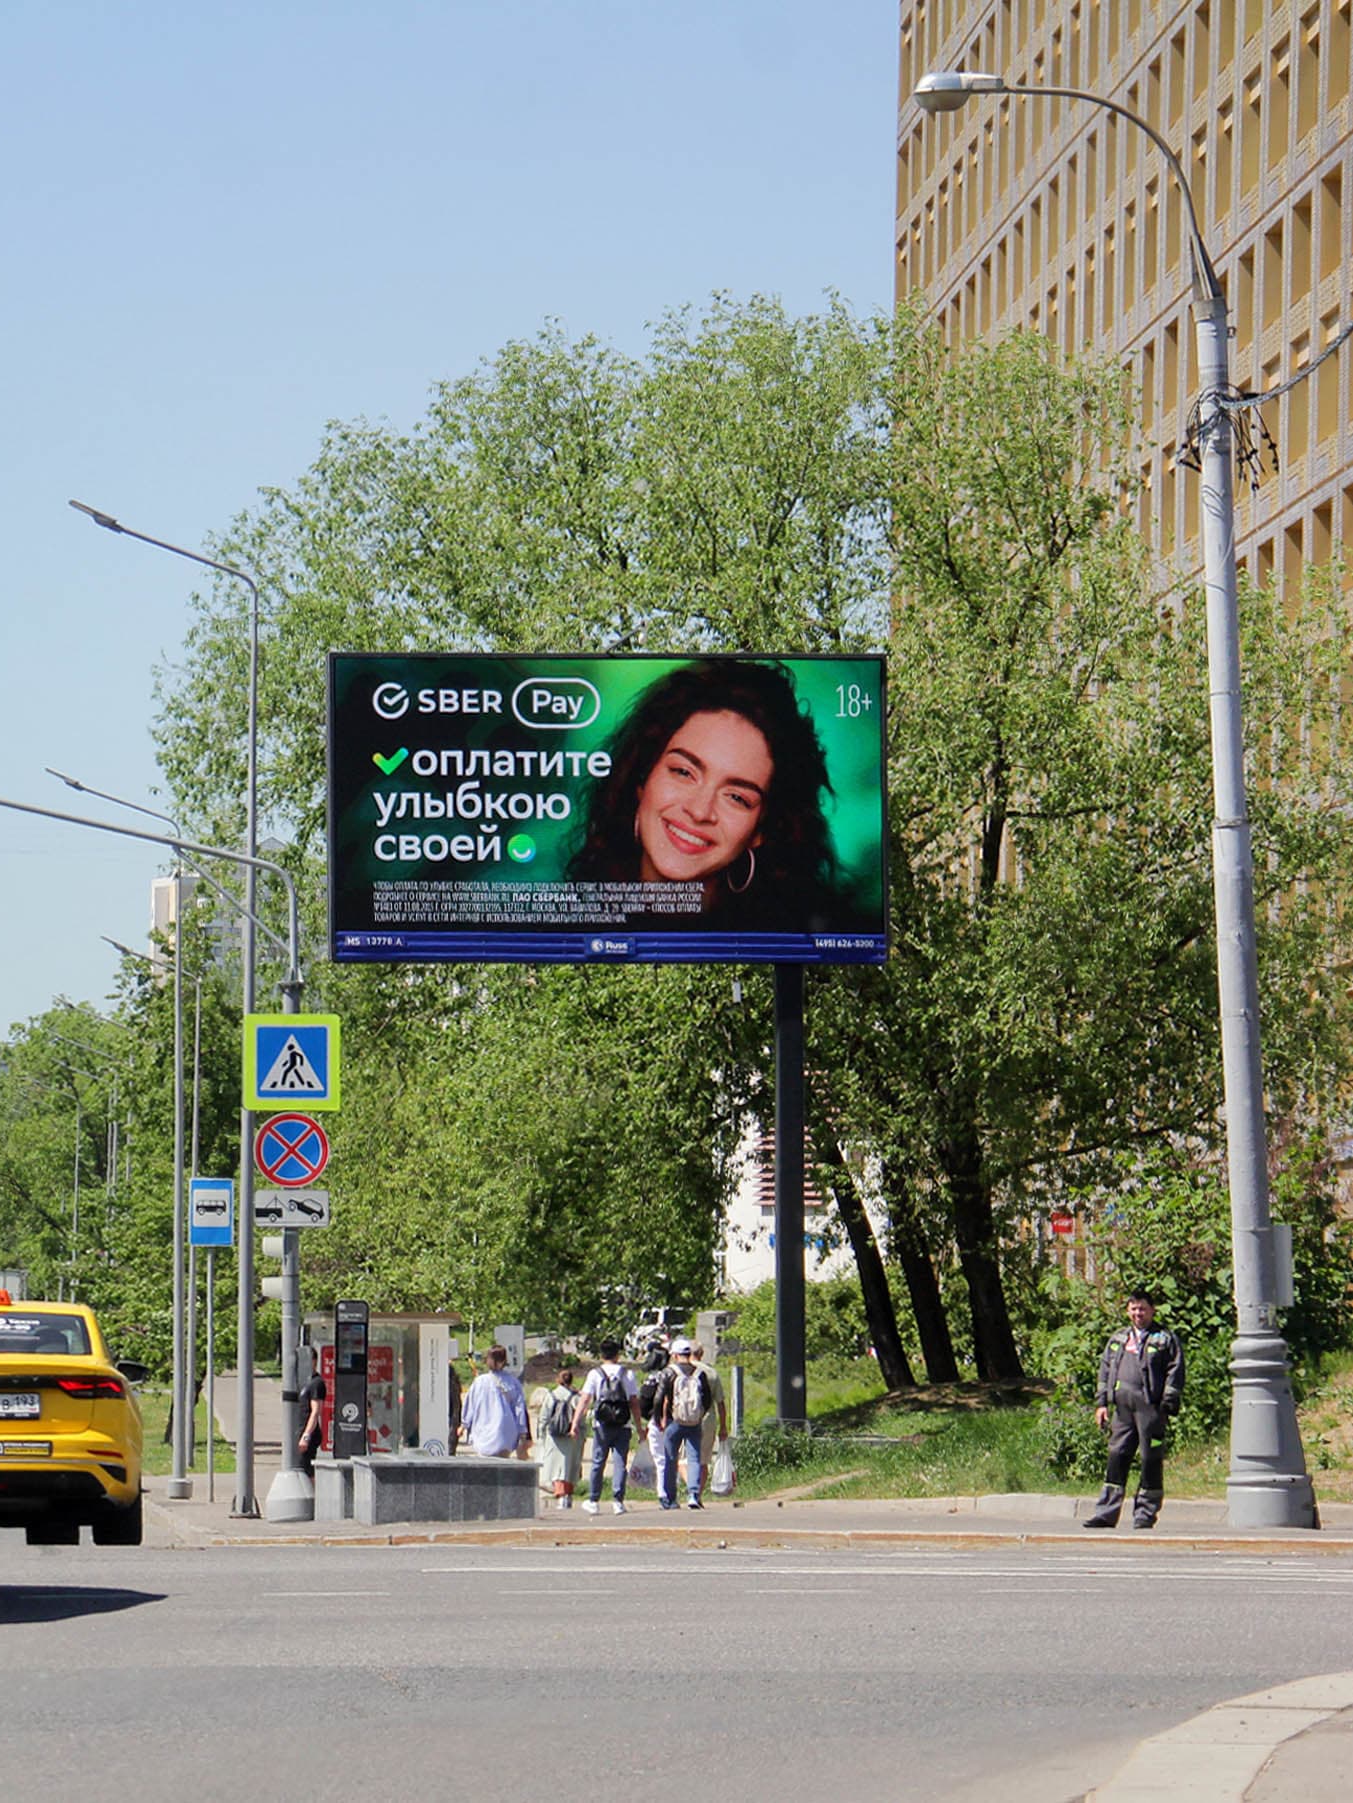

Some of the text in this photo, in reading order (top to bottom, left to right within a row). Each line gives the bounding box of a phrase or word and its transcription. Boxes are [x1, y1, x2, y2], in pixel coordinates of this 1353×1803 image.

[417, 688, 585, 721] SBER Pay
[835, 684, 872, 718] 18+
[411, 749, 613, 777] оплатите
[372, 780, 572, 828] улыбкою
[373, 824, 502, 862] своей
[15, 1395, 36, 1407] 193
